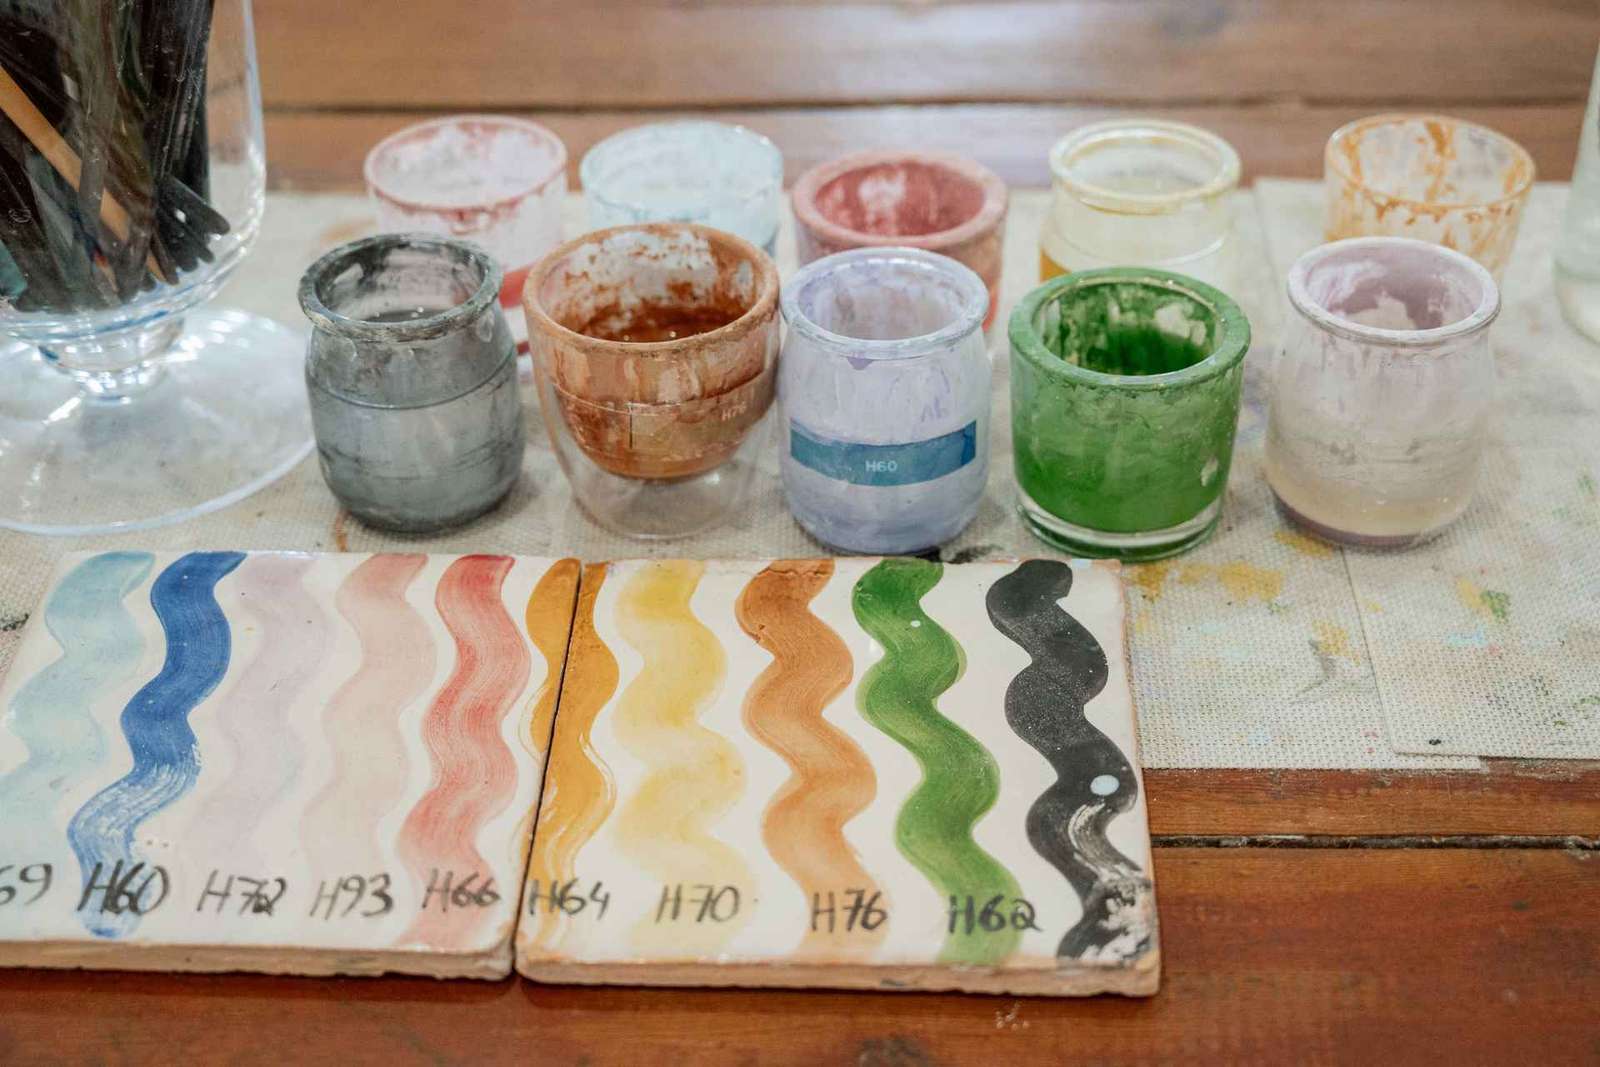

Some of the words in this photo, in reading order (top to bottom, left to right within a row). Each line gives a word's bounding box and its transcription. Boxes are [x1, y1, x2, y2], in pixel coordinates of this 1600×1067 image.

[865, 460, 898, 472] H60
[76, 859, 171, 916] H60
[309, 872, 393, 921] H93
[421, 867, 501, 913] H66
[529, 877, 610, 921] H64
[655, 884, 742, 924] H70
[811, 888, 889, 933] H76
